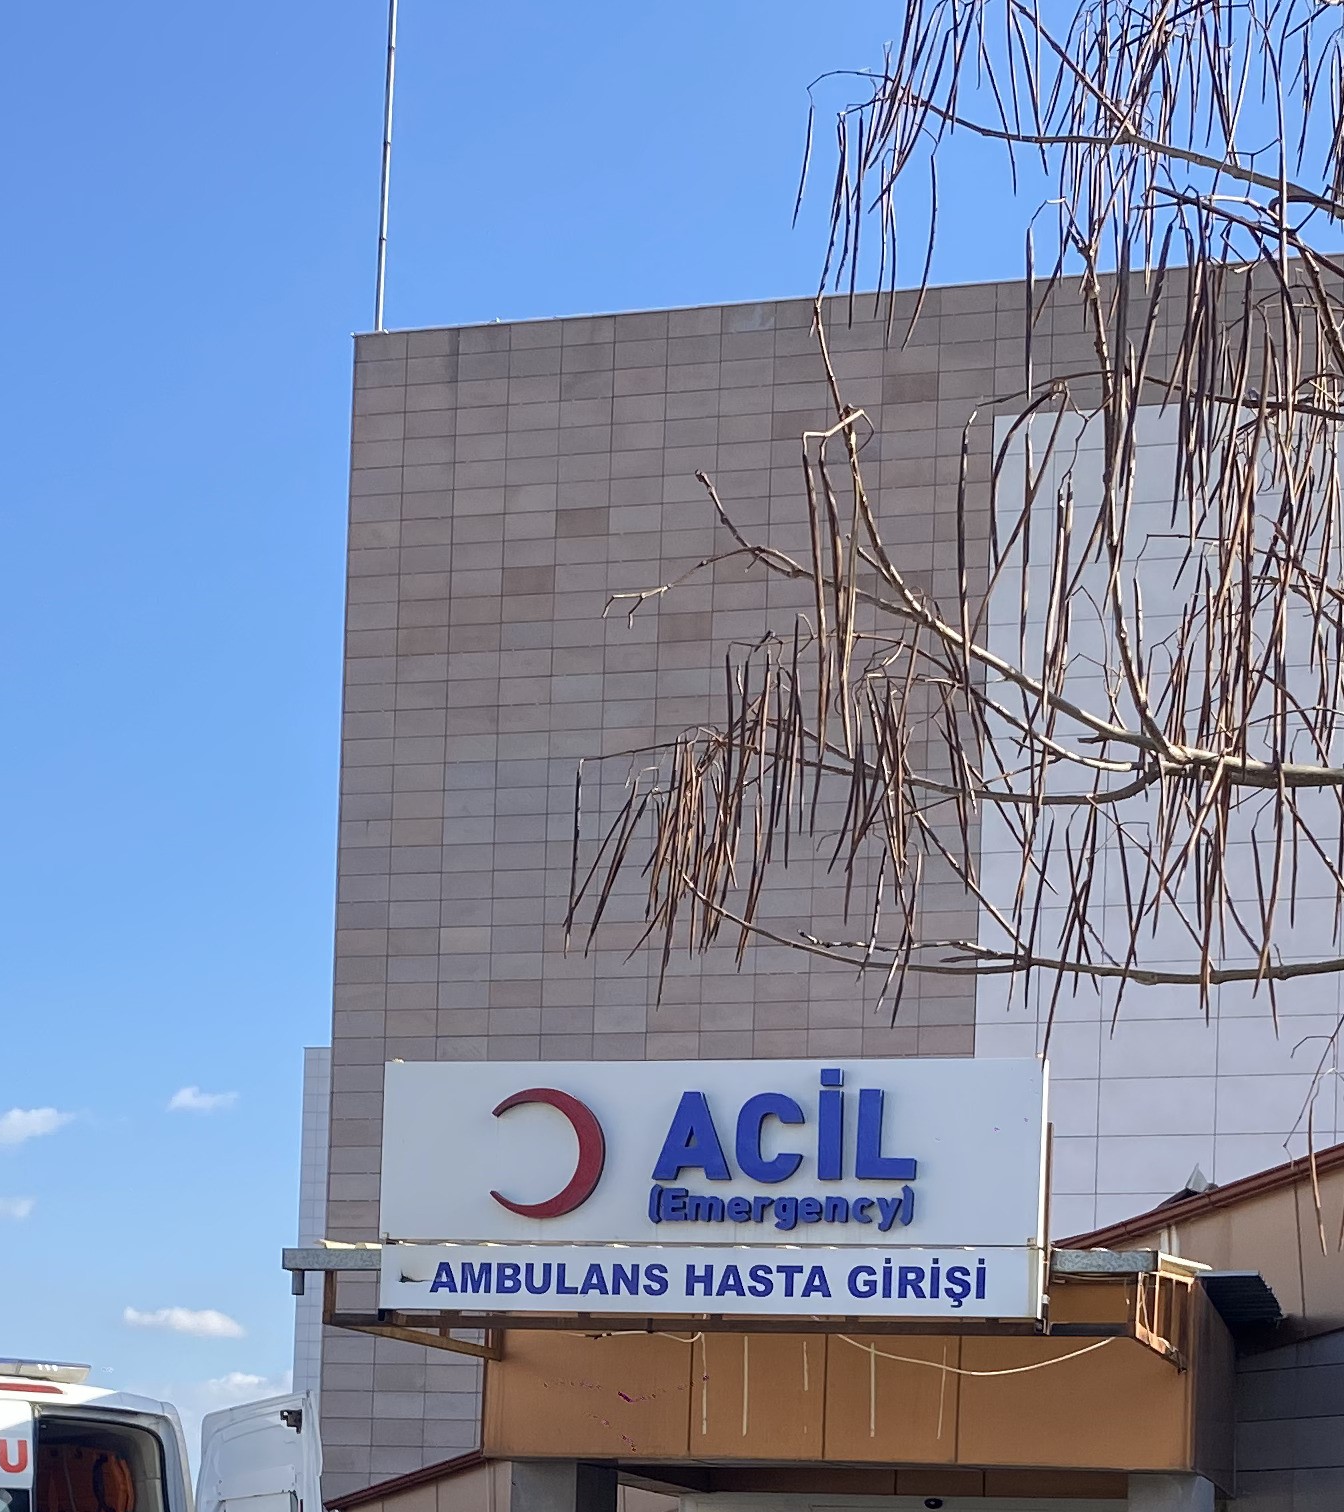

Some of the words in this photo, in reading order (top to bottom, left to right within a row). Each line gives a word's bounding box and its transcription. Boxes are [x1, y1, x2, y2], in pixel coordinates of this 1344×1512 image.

[651, 1068, 917, 1184] ACİL
[648, 1183, 915, 1232] (Emergency)
[429, 1261, 669, 1296] AMBULANS
[685, 1263, 832, 1298] HASTA
[847, 1257, 987, 1308] GİRİŞİ
